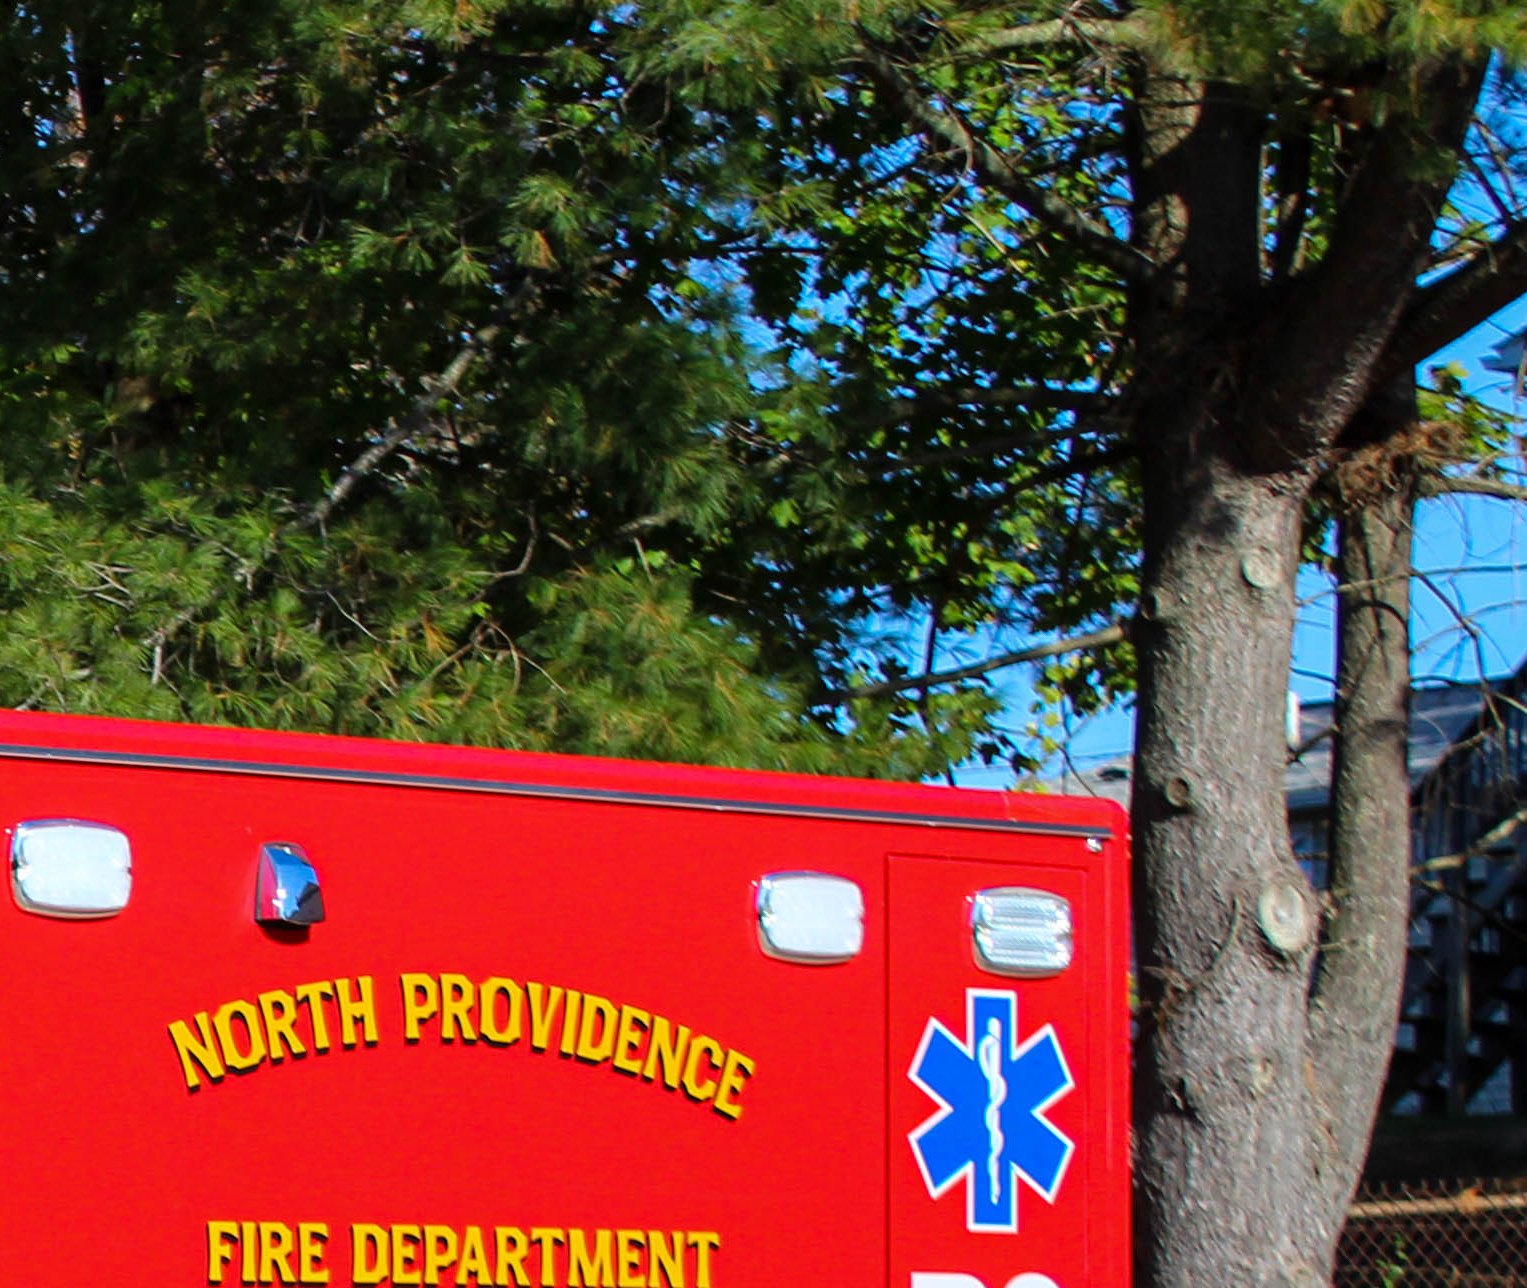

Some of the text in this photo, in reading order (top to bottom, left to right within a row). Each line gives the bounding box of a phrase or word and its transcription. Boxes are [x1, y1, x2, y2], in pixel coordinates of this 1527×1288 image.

[168, 972, 756, 1120] NORTH PROVIDENCE
[206, 1220, 330, 1285] FIRE
